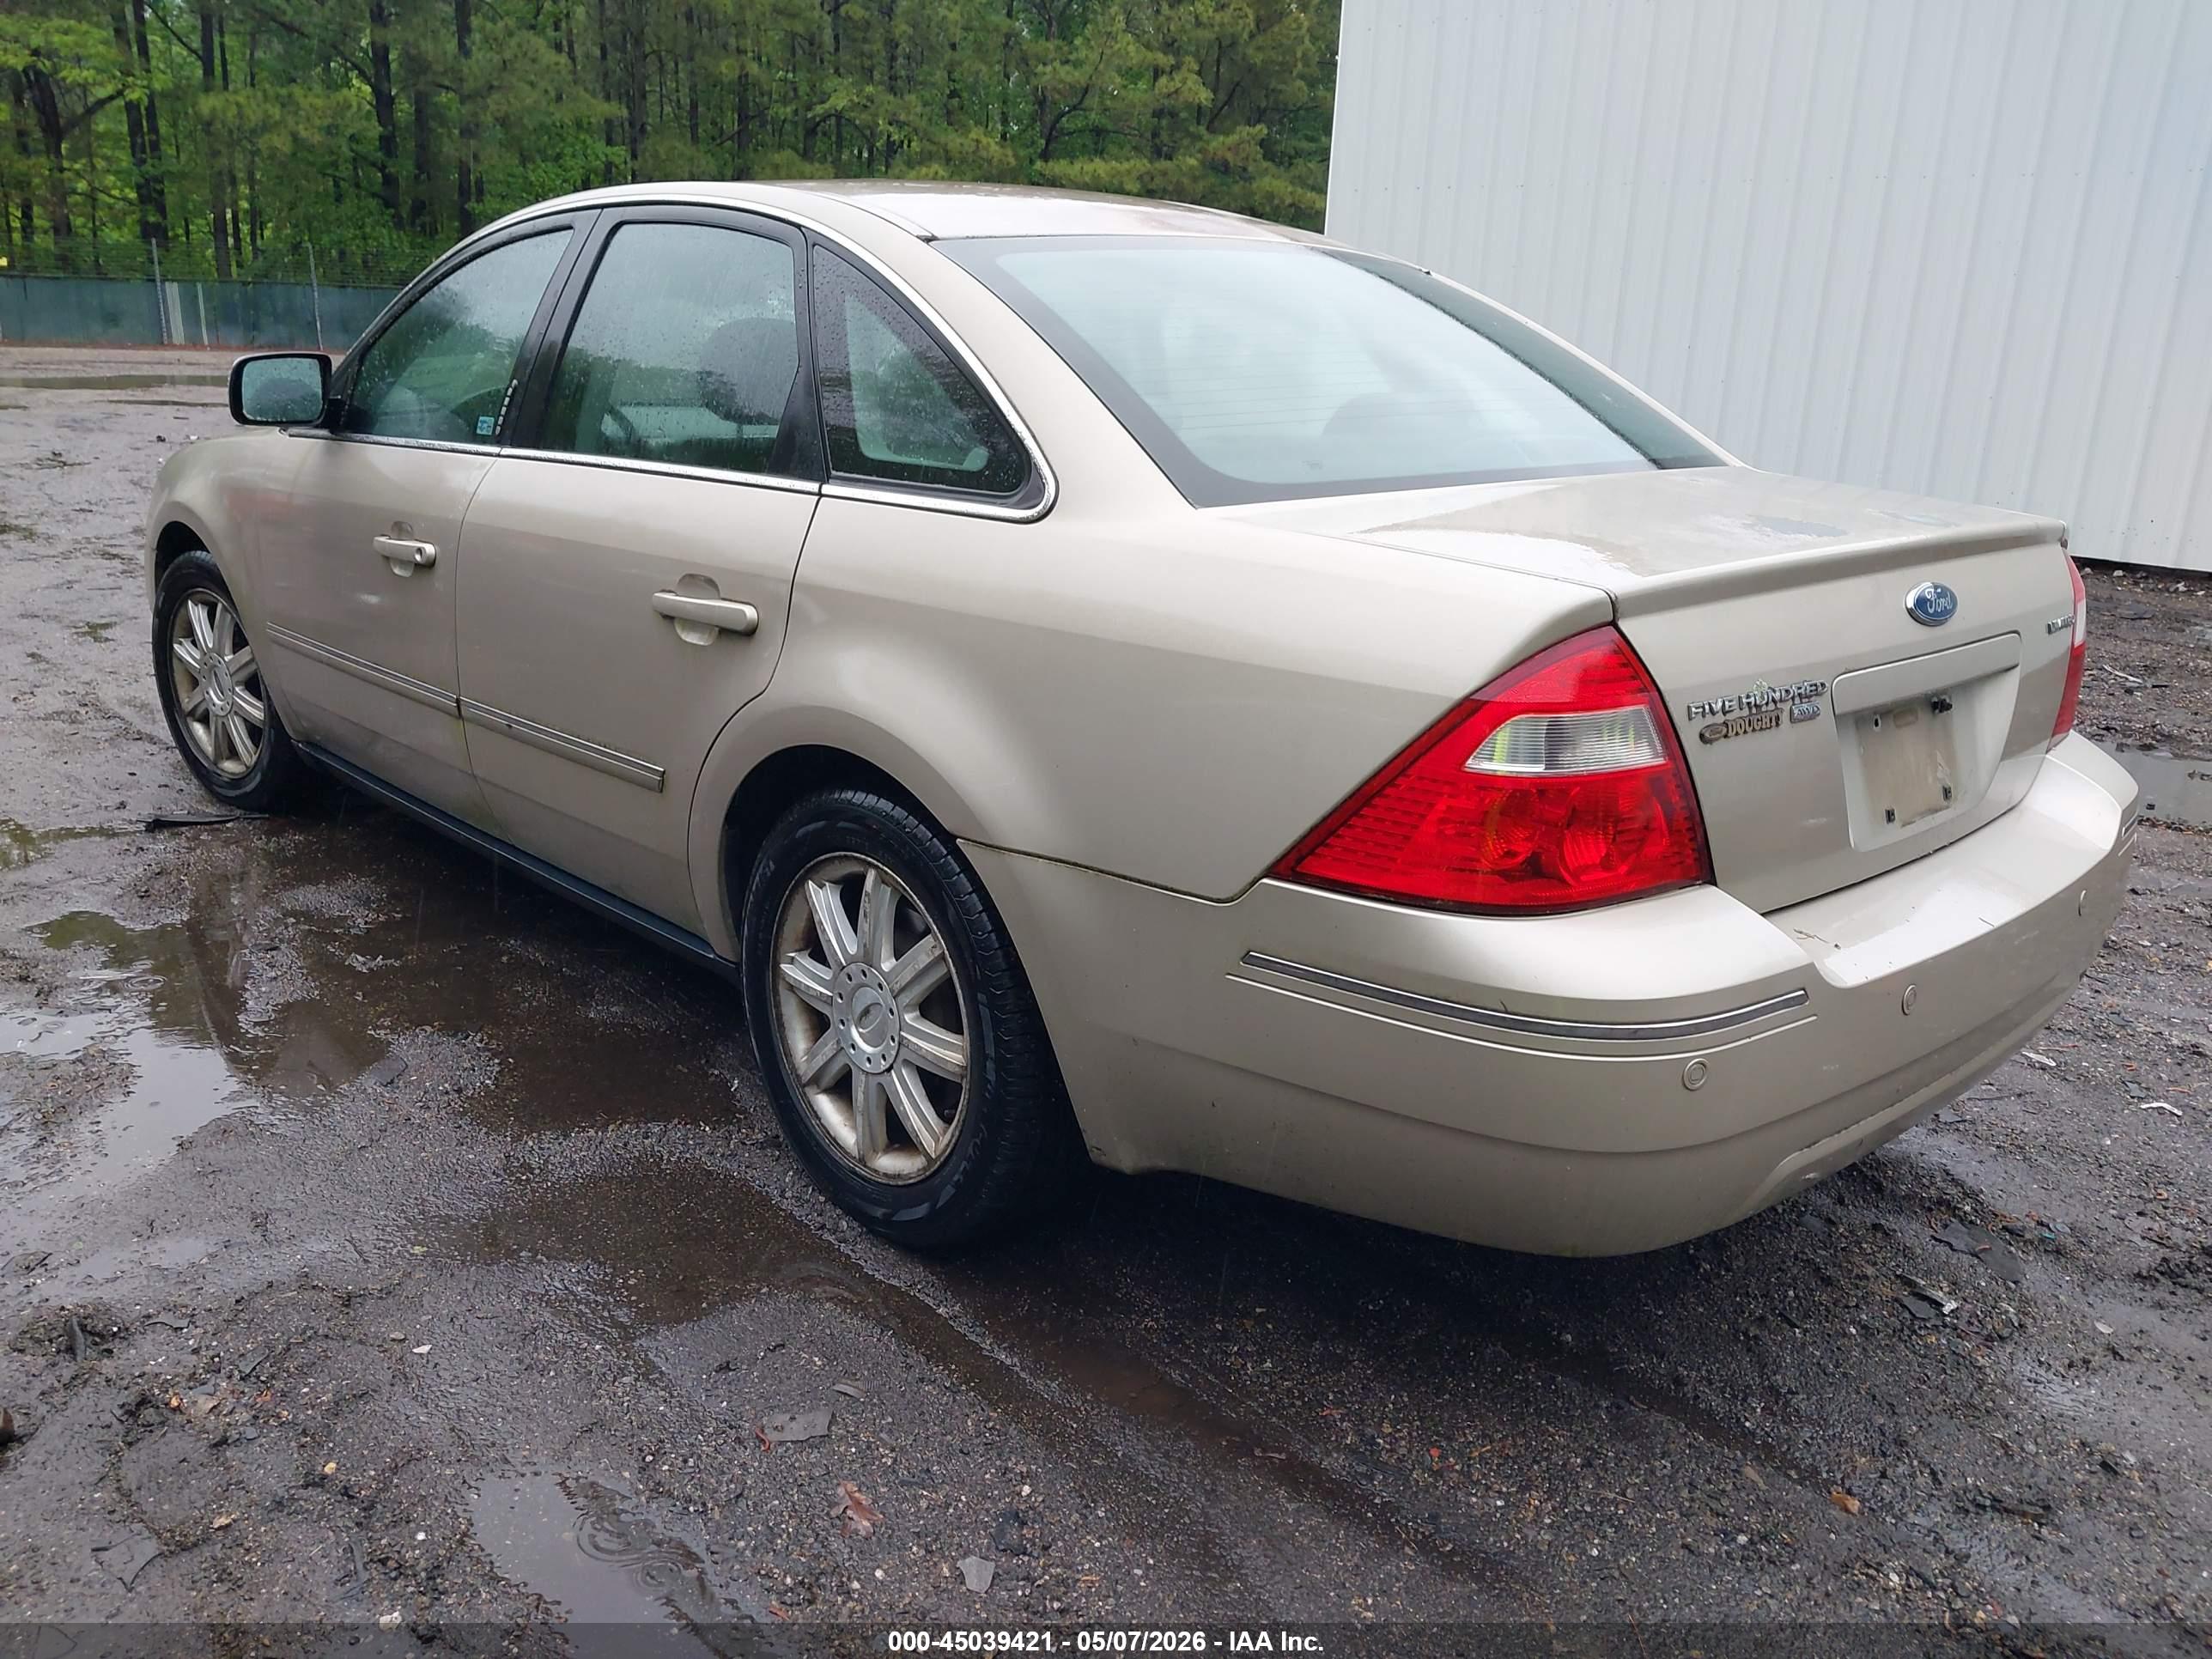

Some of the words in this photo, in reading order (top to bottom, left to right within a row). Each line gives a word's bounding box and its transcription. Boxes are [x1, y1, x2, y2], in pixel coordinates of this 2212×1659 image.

[1924, 587, 1953, 613] Ford
[1688, 695, 1737, 720] FIVE
[1738, 679, 1829, 708] HUNDRED
[1792, 702, 1821, 720] AWD
